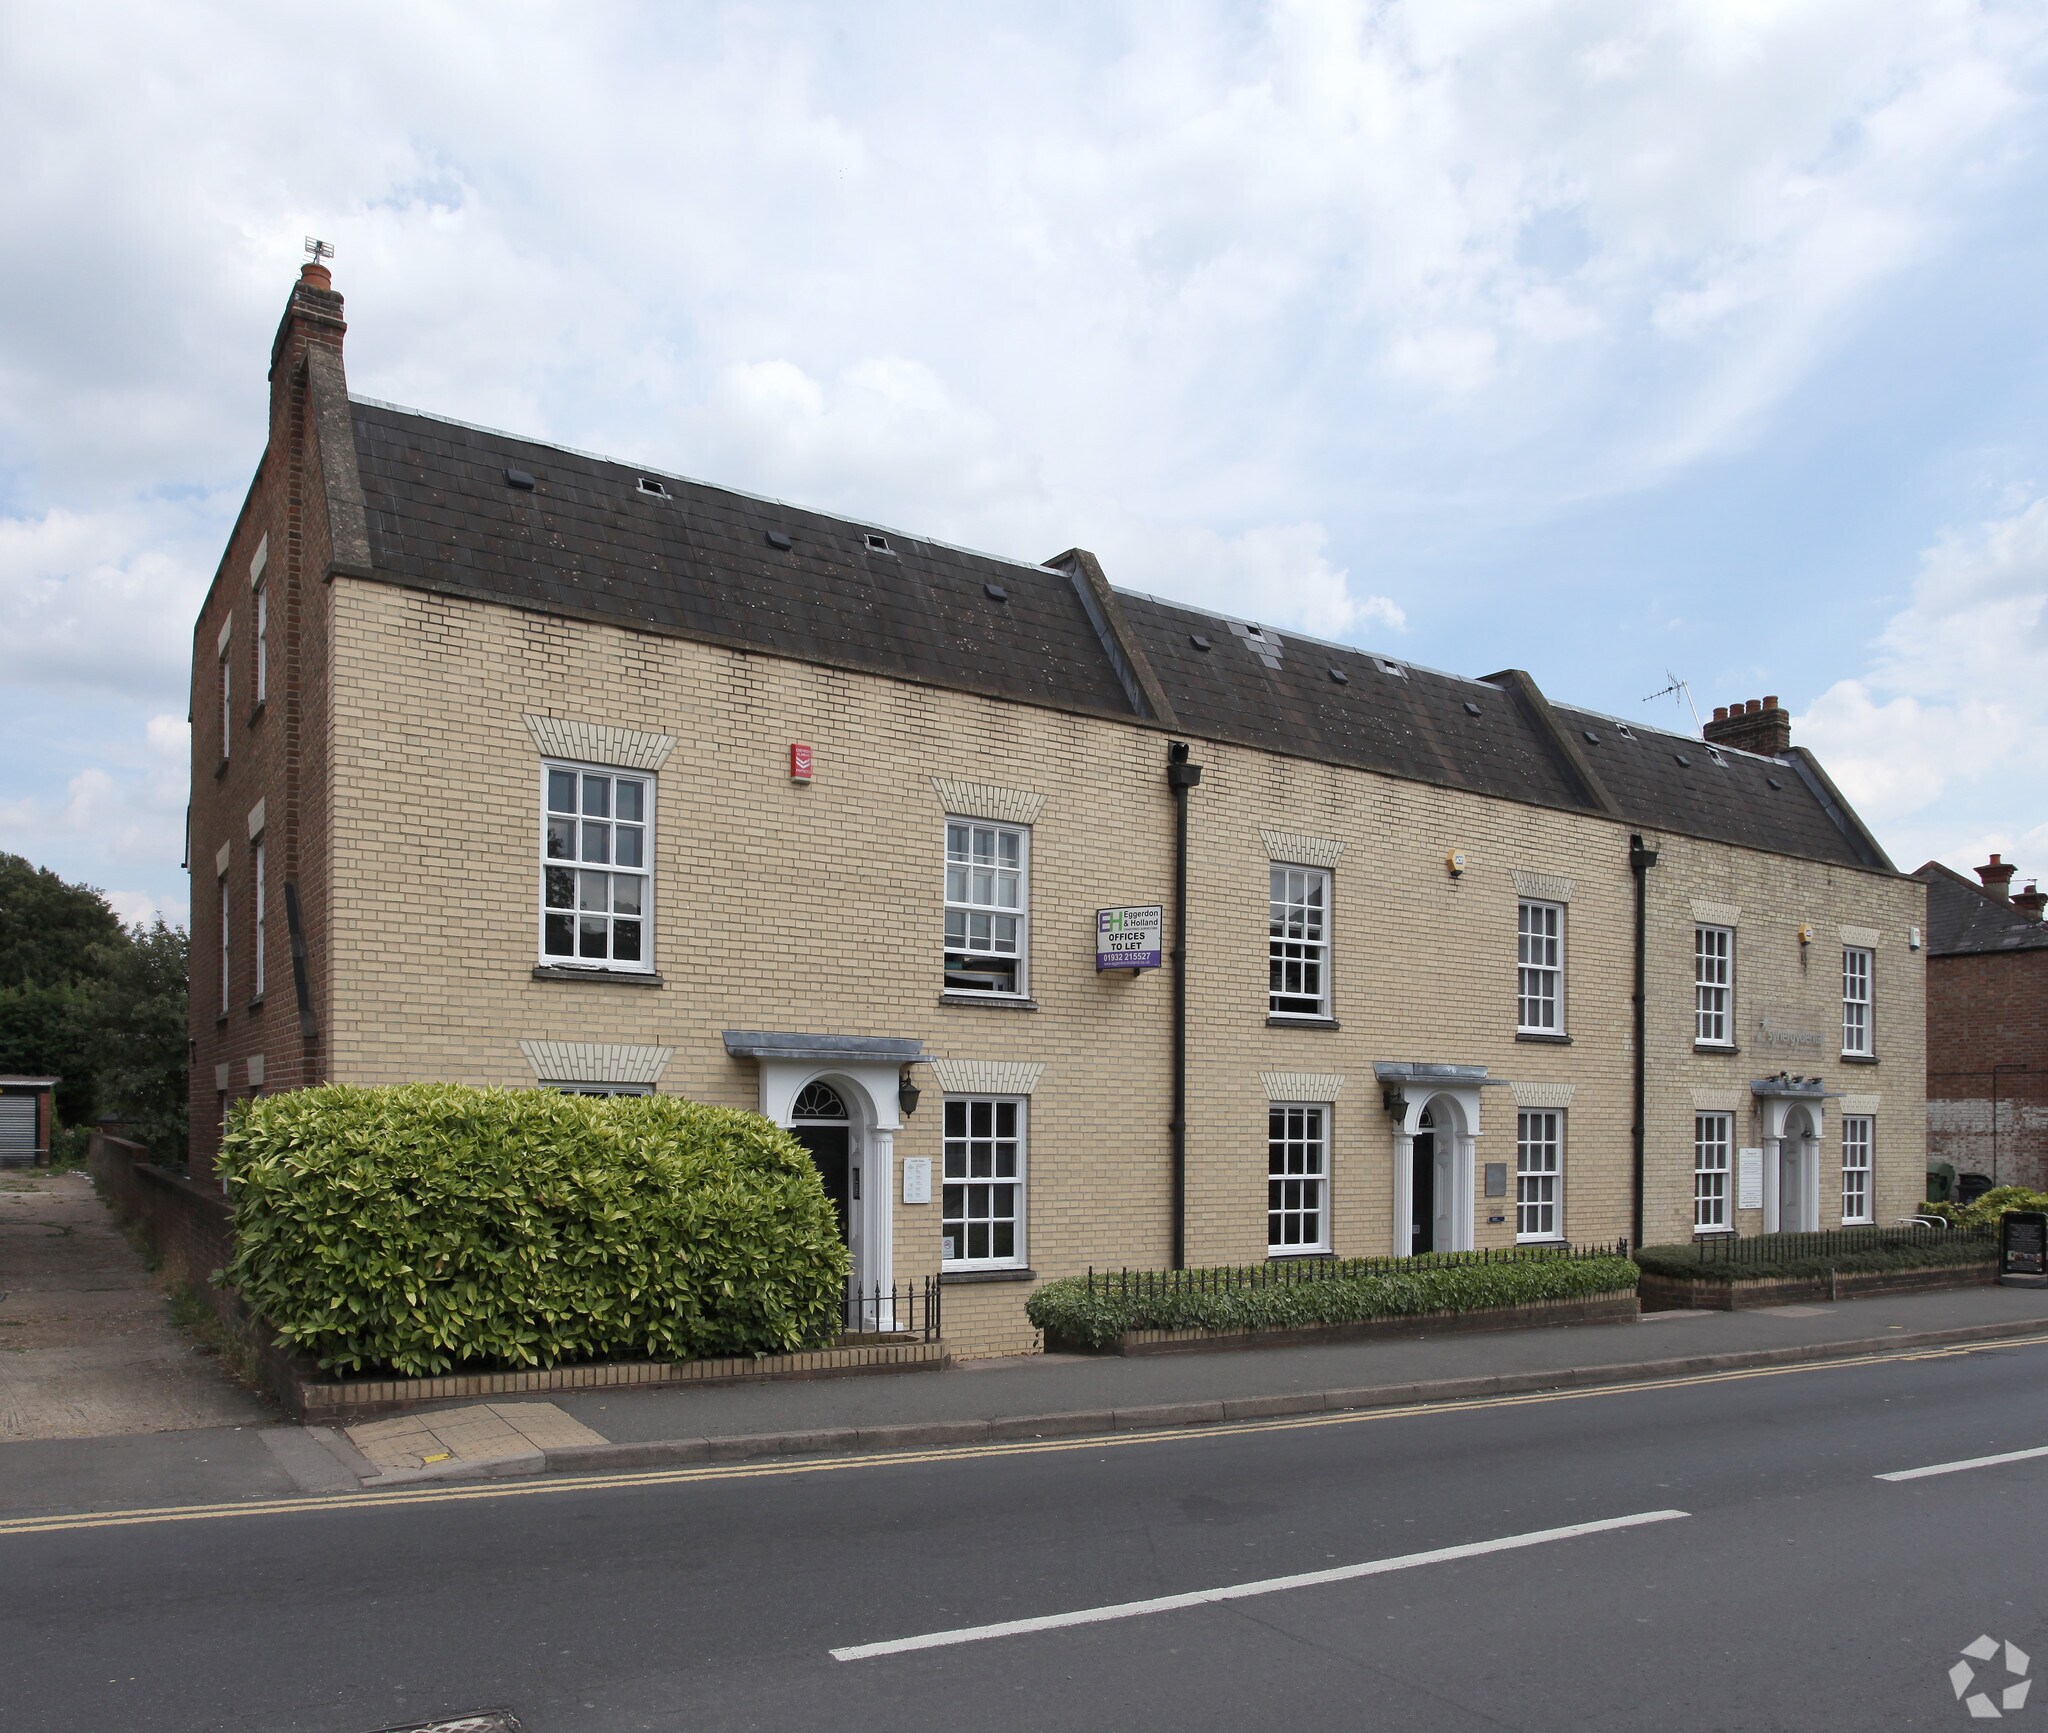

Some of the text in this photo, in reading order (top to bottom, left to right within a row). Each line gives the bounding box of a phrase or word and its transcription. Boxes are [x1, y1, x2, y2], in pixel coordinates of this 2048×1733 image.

[1124, 911, 1158, 919] Eggerdon
[1109, 932, 1145, 941] OFFICES
[1111, 942, 1142, 951] TO LET
[1103, 952, 1151, 962] 01932 215527
